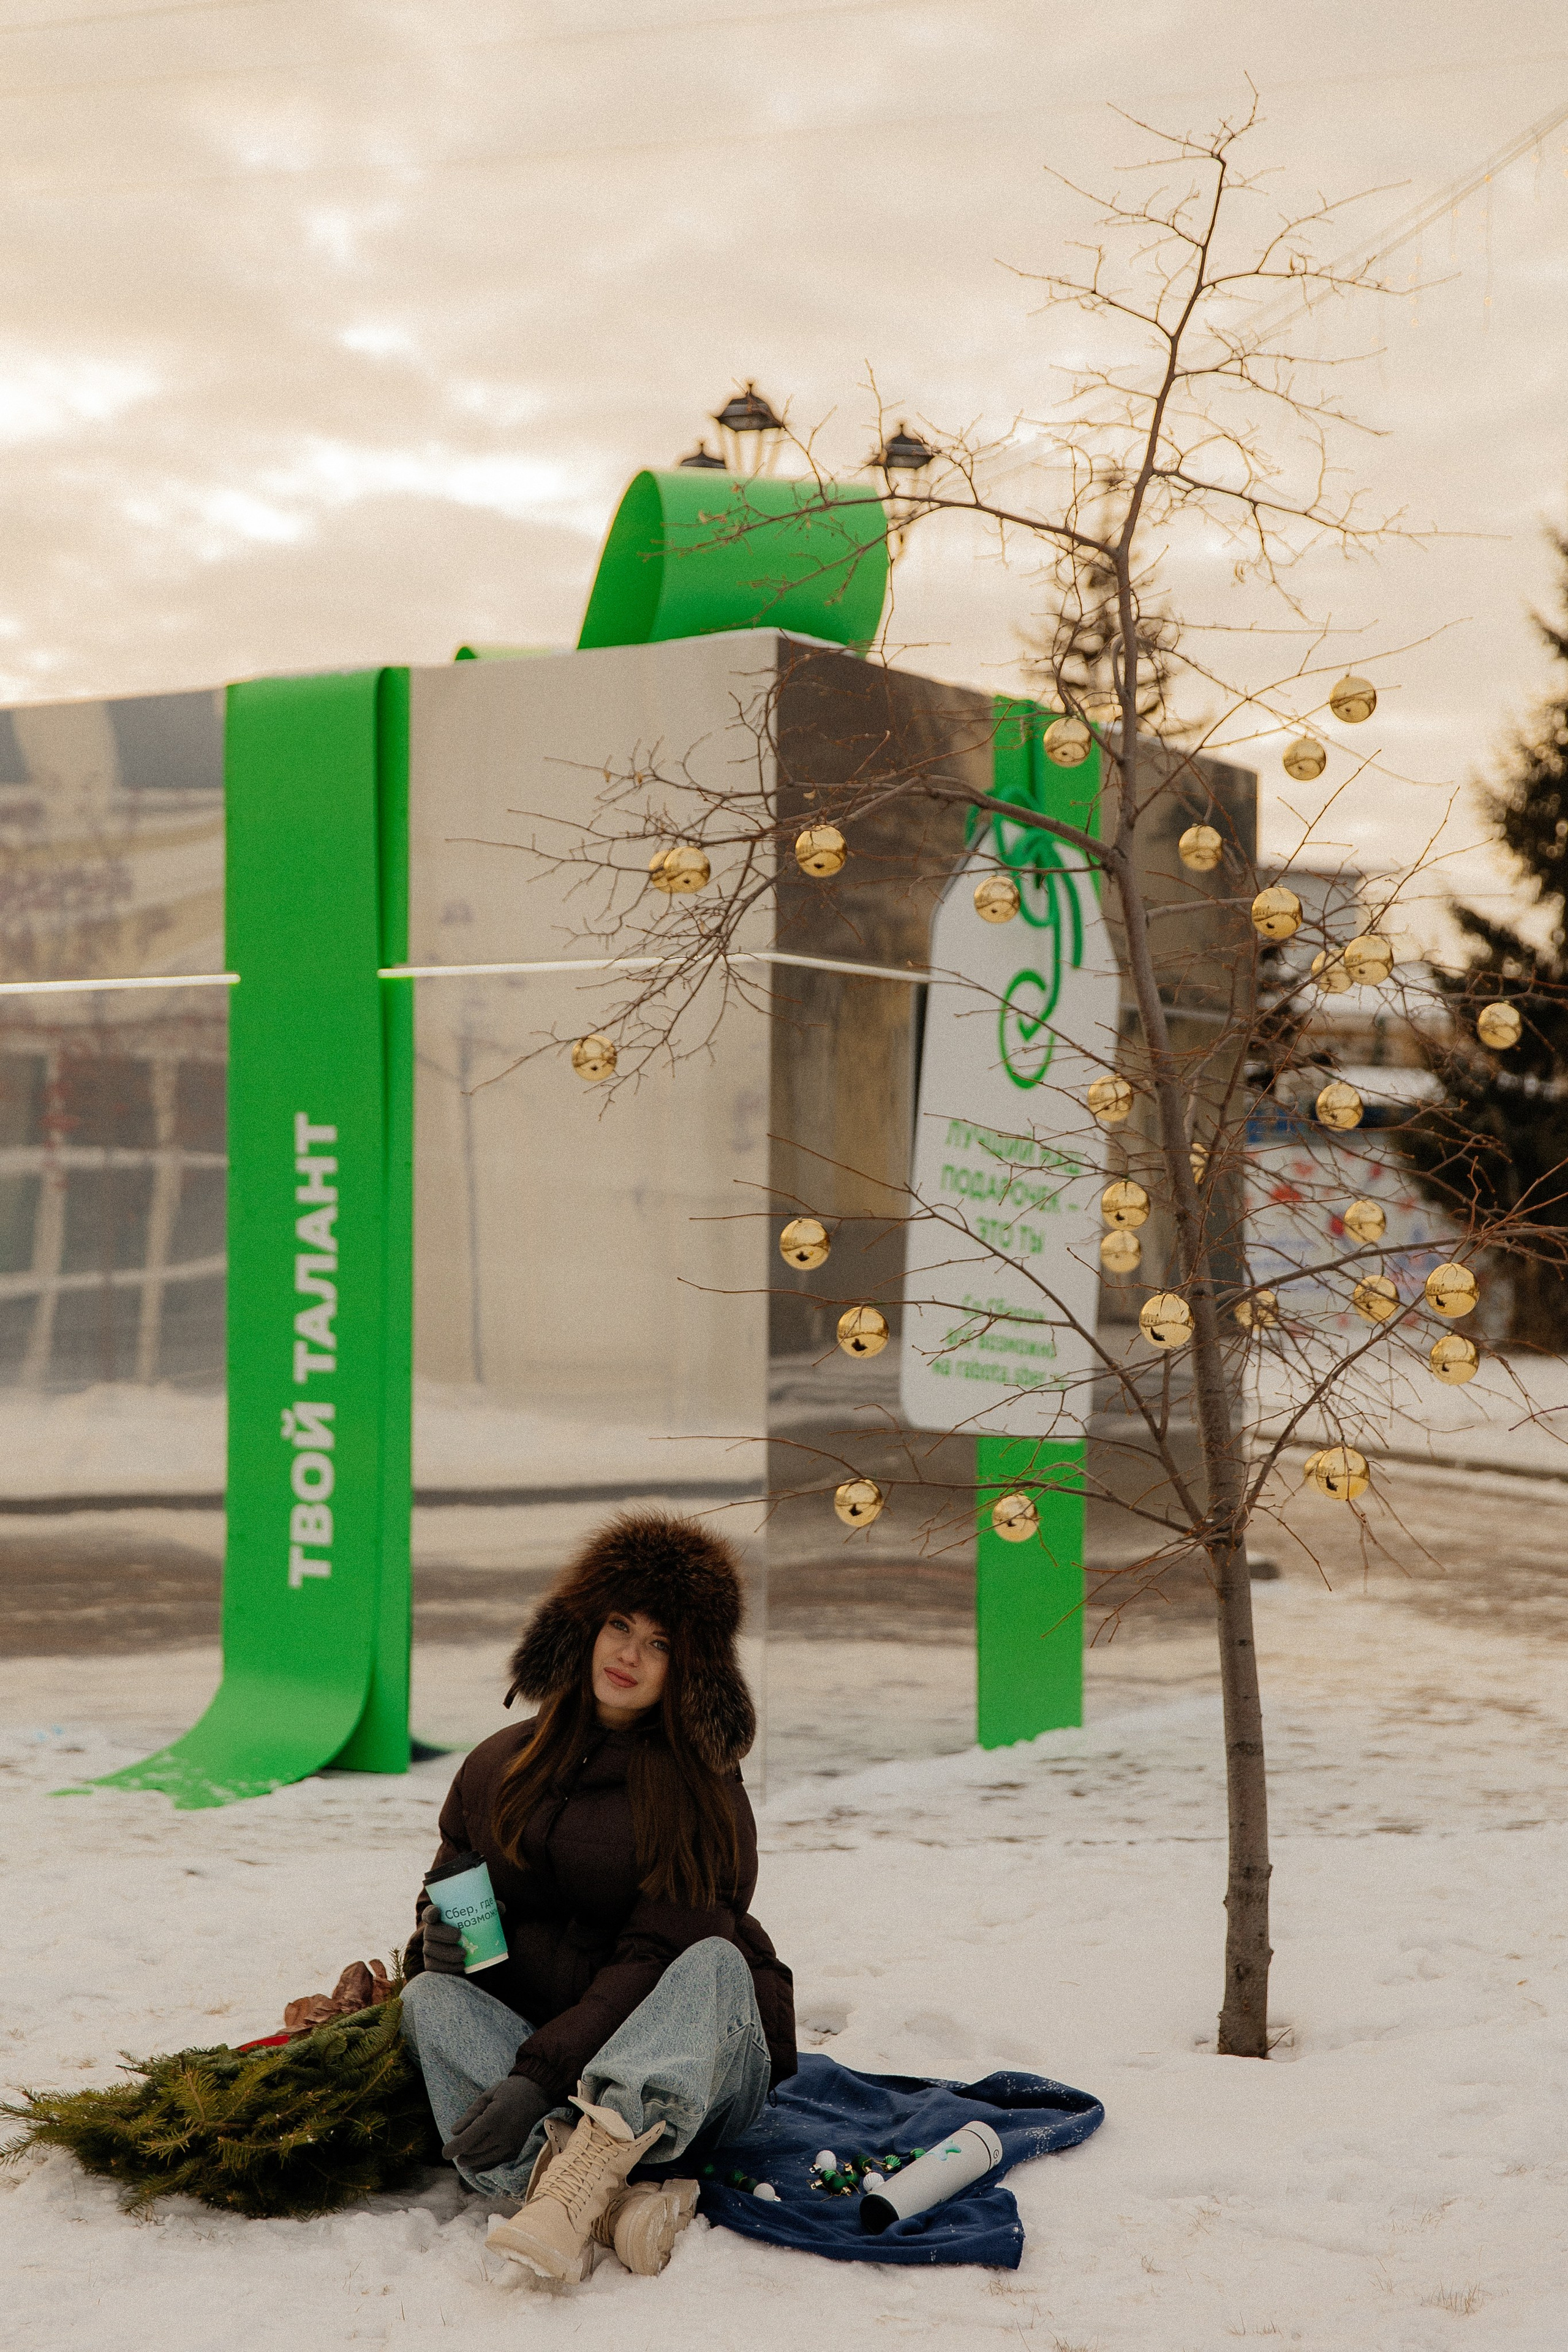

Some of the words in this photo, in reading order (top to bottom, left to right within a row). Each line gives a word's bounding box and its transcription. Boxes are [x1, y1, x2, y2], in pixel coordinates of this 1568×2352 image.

[293, 1111, 340, 1385] ТАЛАНТ
[282, 1401, 335, 1591] ТВОЙ
[445, 1906, 478, 1920] Сбер,
[480, 1898, 494, 1909] где
[457, 1908, 498, 1929] возмож
